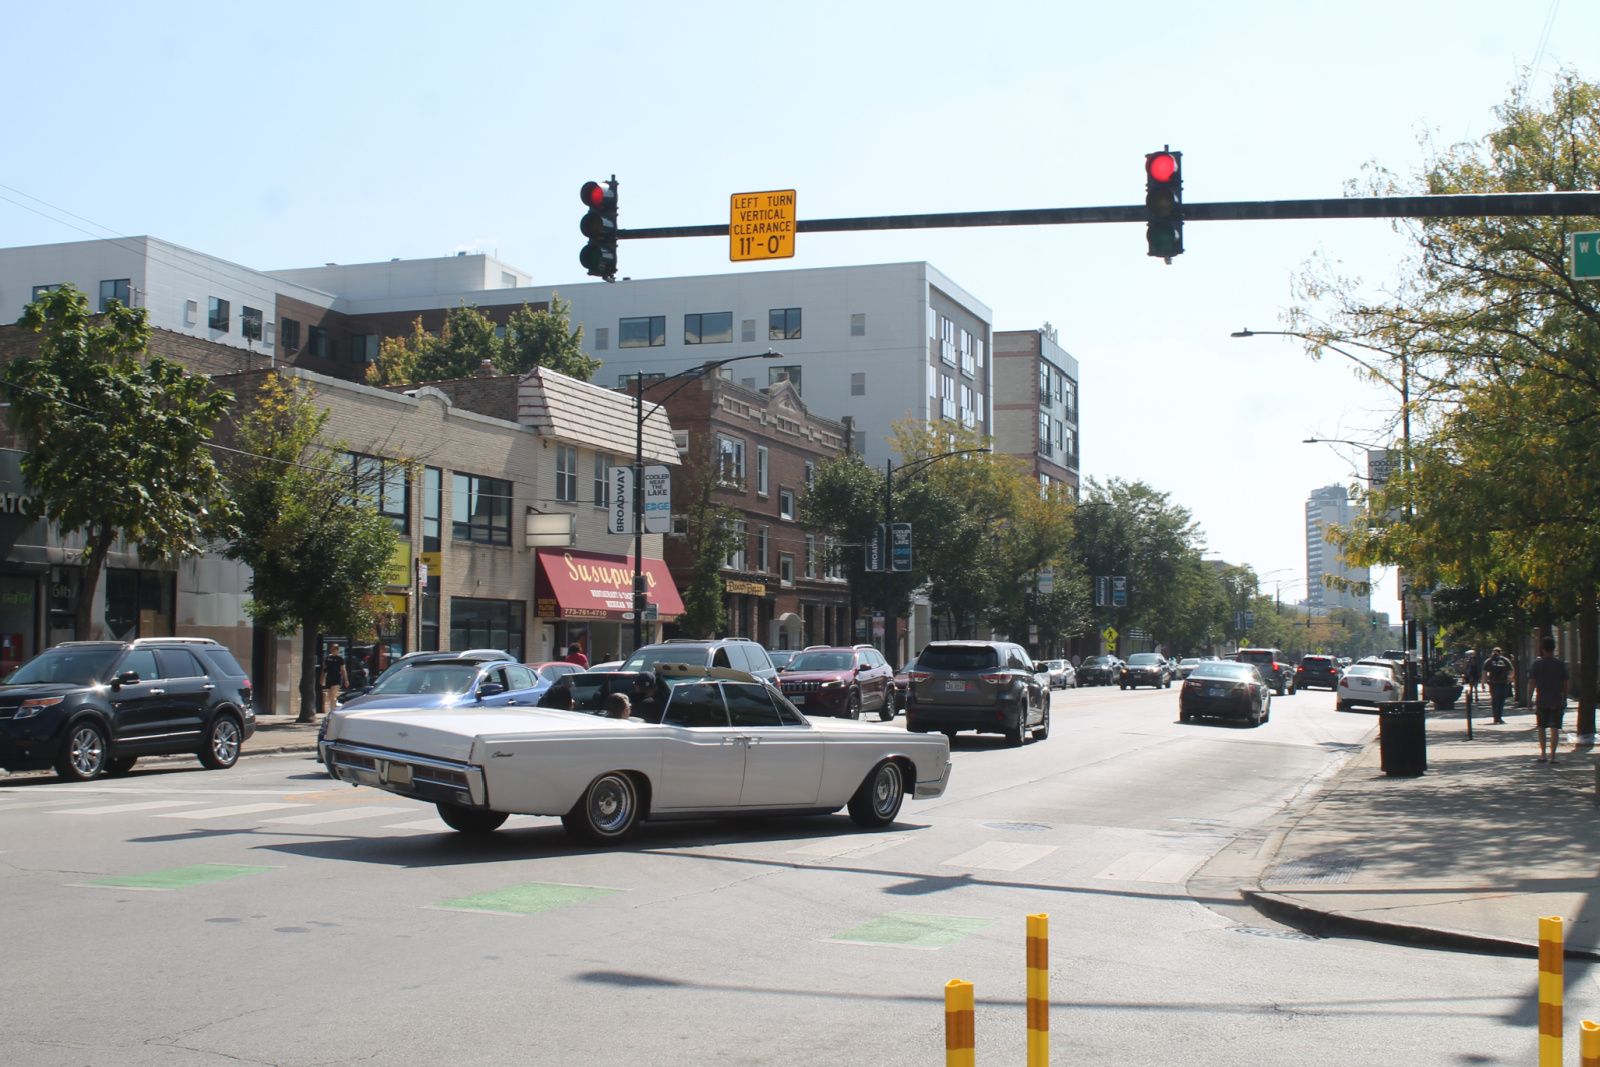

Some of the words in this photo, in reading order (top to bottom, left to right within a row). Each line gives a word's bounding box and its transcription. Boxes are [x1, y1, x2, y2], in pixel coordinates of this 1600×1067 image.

[735, 197, 759, 209] LEFT
[768, 194, 792, 207] TURN
[740, 208, 785, 221] VERTICAL
[734, 220, 791, 235] CLEARANCE
[1579, 241, 1589, 254] W
[616, 468, 625, 532] BROADWAY
[647, 489, 668, 497] LAKE
